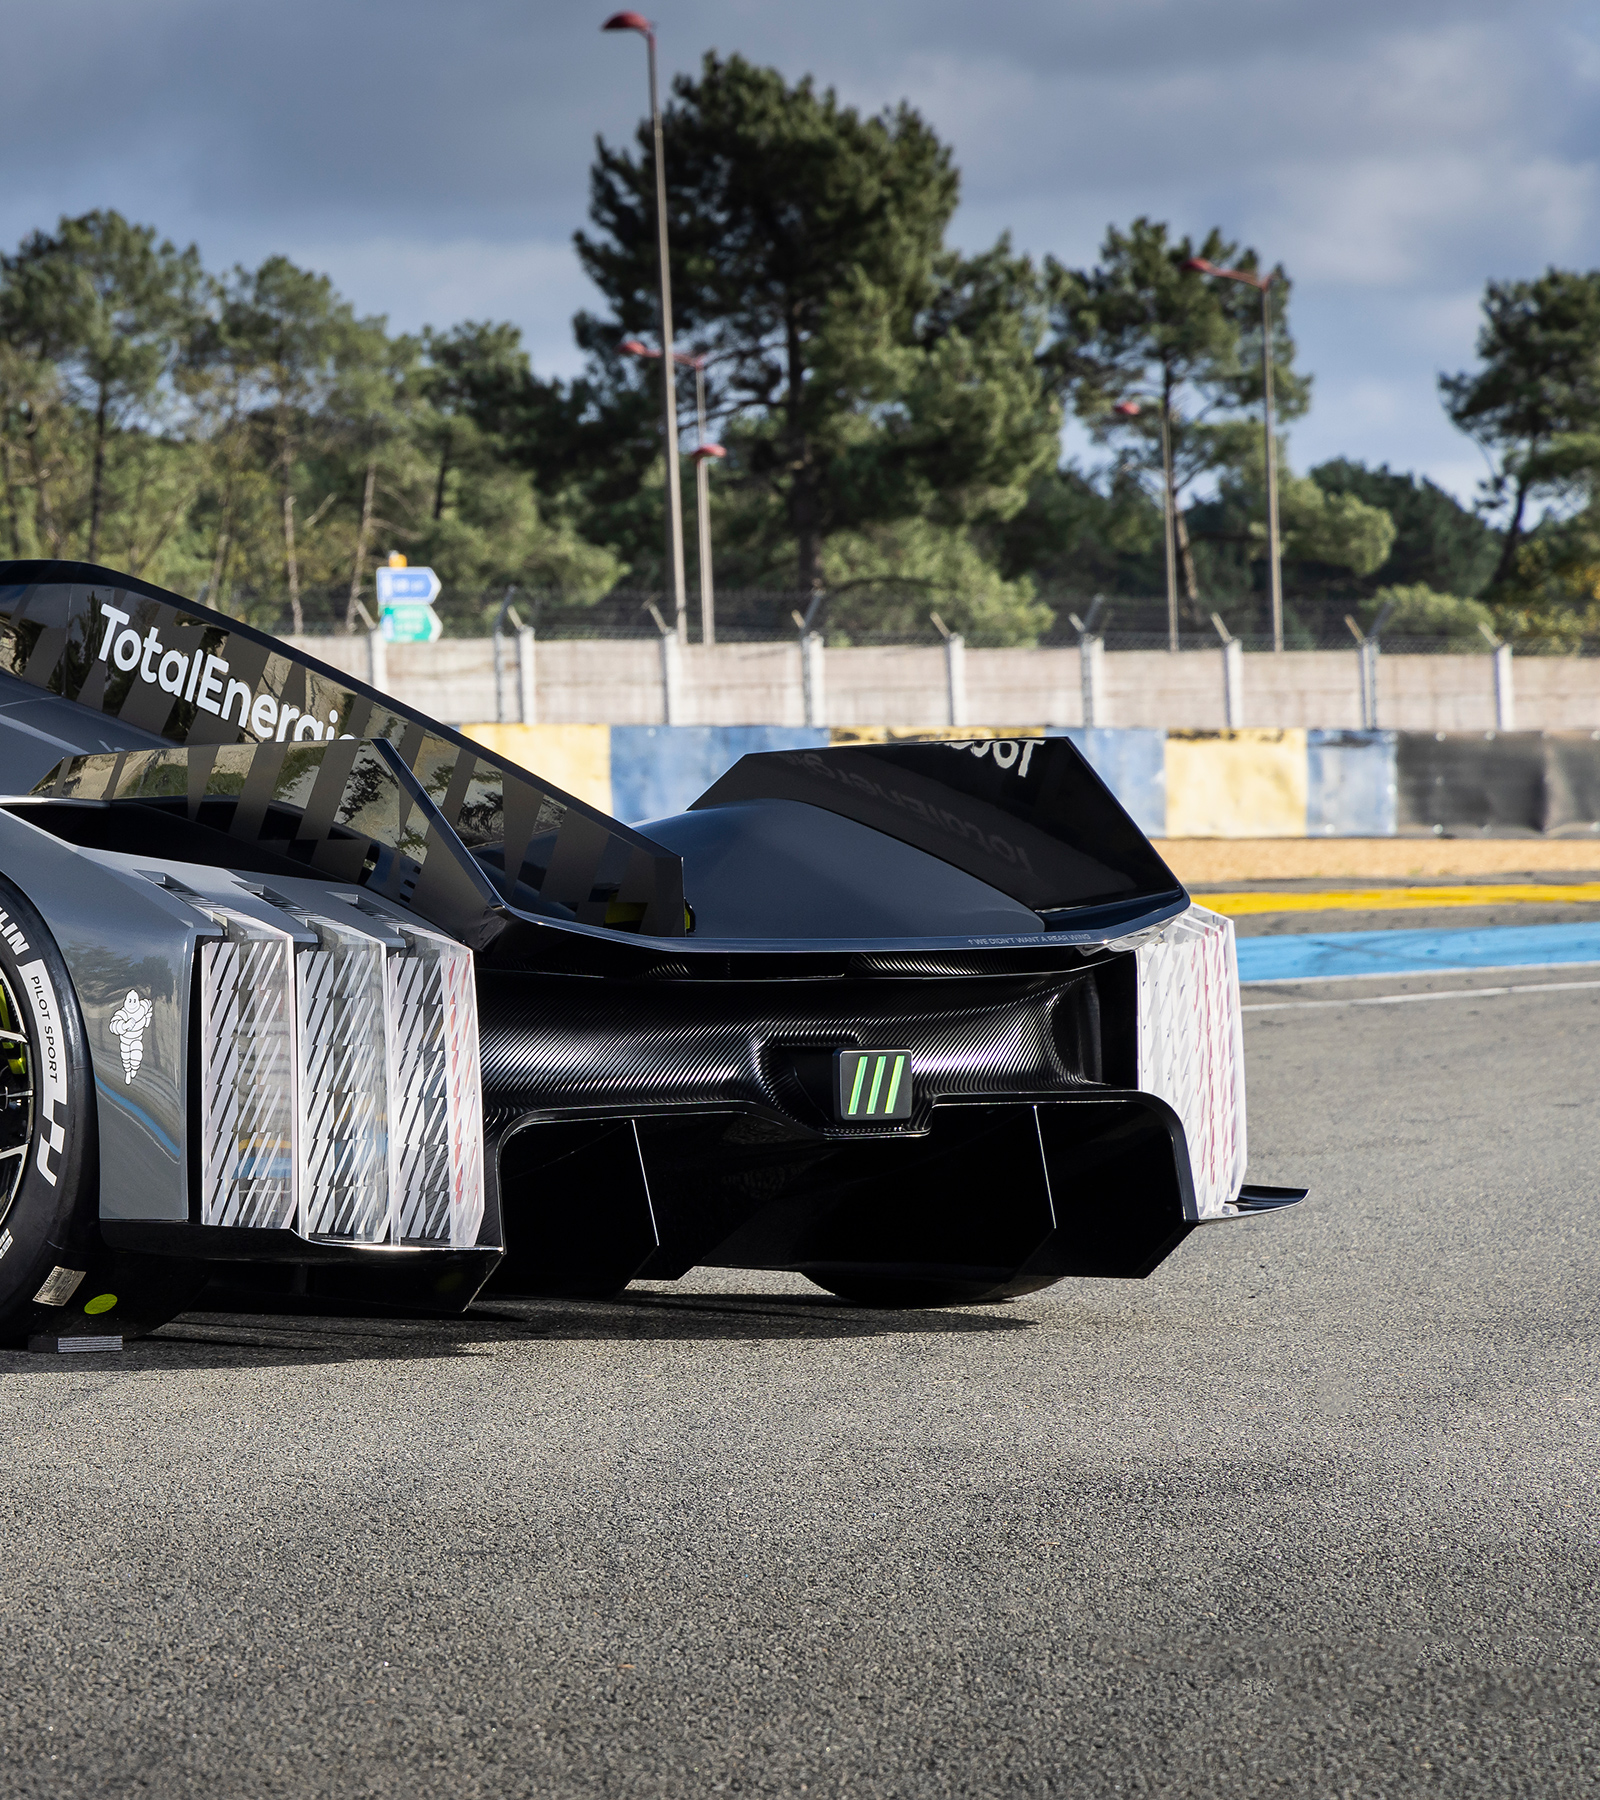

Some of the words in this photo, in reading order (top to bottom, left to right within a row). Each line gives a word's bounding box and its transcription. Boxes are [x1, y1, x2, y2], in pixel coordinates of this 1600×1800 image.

[98, 603, 355, 742] TotalEner
[1015, 936, 1039, 944] WANT
[1047, 934, 1069, 942] REAR
[31, 975, 50, 1021] PILOT
[44, 1025, 58, 1084] SPORT
